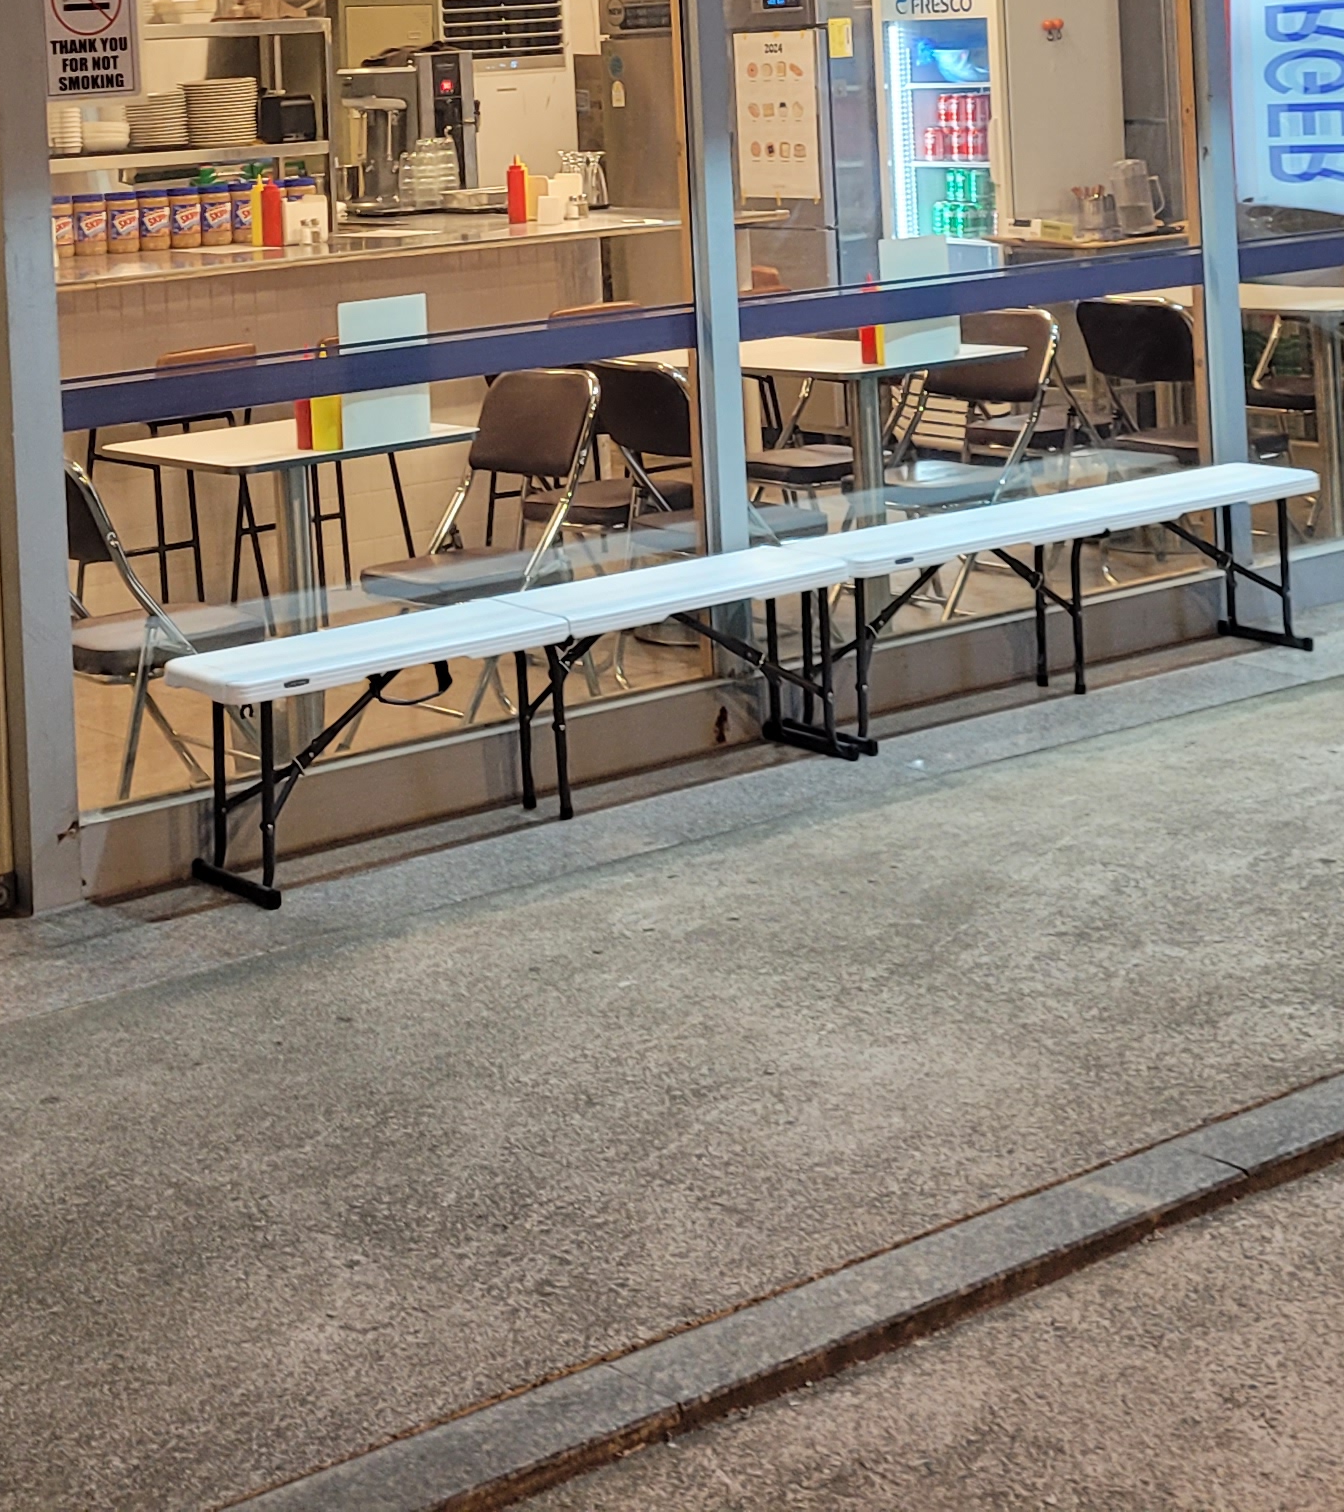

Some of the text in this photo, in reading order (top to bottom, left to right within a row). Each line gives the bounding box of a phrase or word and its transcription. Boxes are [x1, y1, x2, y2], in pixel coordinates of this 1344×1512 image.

[49, 36, 128, 55] THANK YOU
[62, 55, 119, 73] FOR NOT
[58, 73, 125, 91] SMOKING
